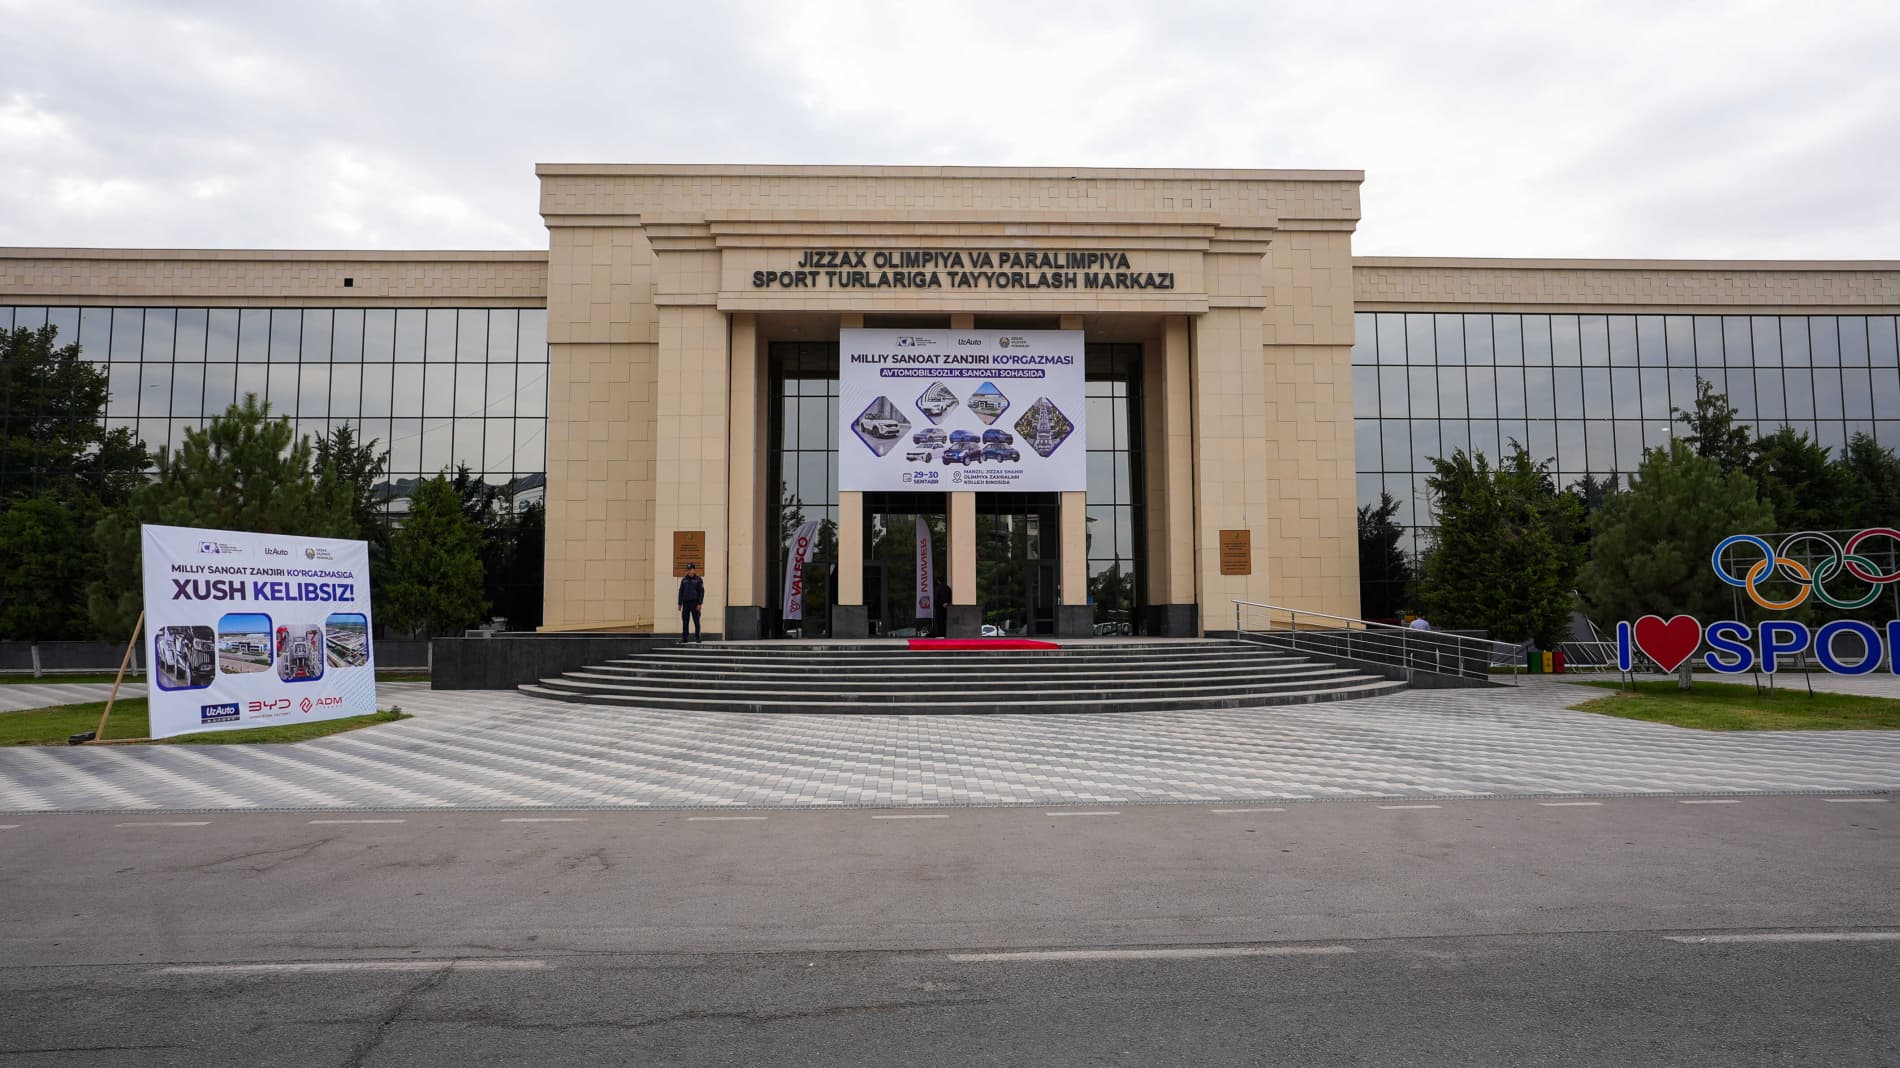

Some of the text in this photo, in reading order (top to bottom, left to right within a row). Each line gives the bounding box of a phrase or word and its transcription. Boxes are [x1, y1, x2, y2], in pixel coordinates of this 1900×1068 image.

[798, 250, 1131, 270] JIZZAX OLIMPIYA VA PARALIMPIYA
[752, 270, 1175, 289] SPORT TURLARIGA TAYYORLASH MARKAZI
[957, 338, 982, 347] UzAuto
[850, 354, 1074, 365] MILLIY SANOAT ZANJIRI KO'RGAZMASI
[881, 368, 1044, 378] AVTOMOBILSOZLIK SANOATI SOHASIDA
[264, 547, 289, 556] UzAuto
[171, 563, 206, 574] MILLIY
[207, 565, 248, 576] SANOAT
[249, 567, 285, 577] ZANJIRI
[791, 536, 808, 596] VALESCO
[172, 578, 355, 602] XUSH KELIBSIZ!
[1616, 620, 1632, 673] I
[248, 699, 291, 712] BYD
[316, 697, 343, 706] ADM
[206, 706, 235, 716] UzAuto
